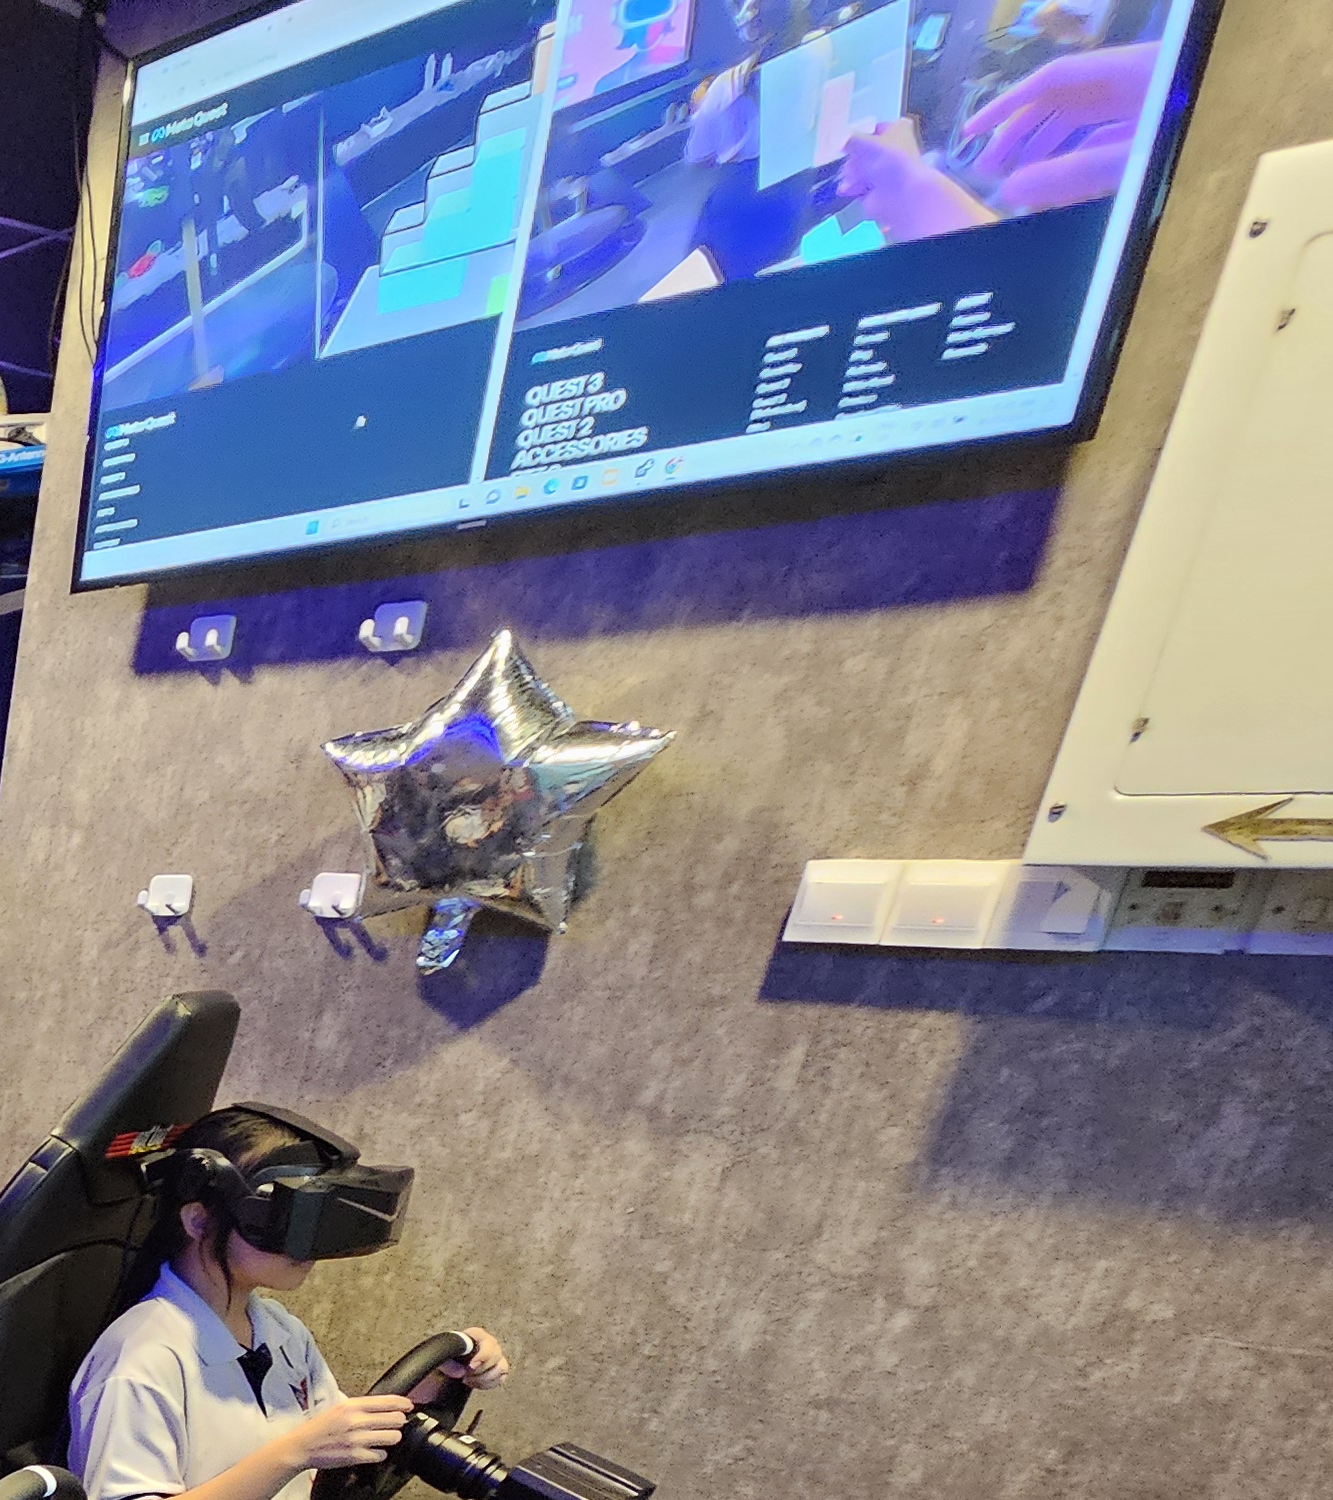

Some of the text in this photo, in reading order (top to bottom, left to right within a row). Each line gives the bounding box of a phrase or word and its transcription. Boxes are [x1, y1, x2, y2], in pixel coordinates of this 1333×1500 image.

[520, 387, 628, 430] QUEST PRO
[525, 374, 588, 408] QUEST
[510, 425, 649, 471] ACCESSORIES
[515, 416, 595, 450] QUEST 2
